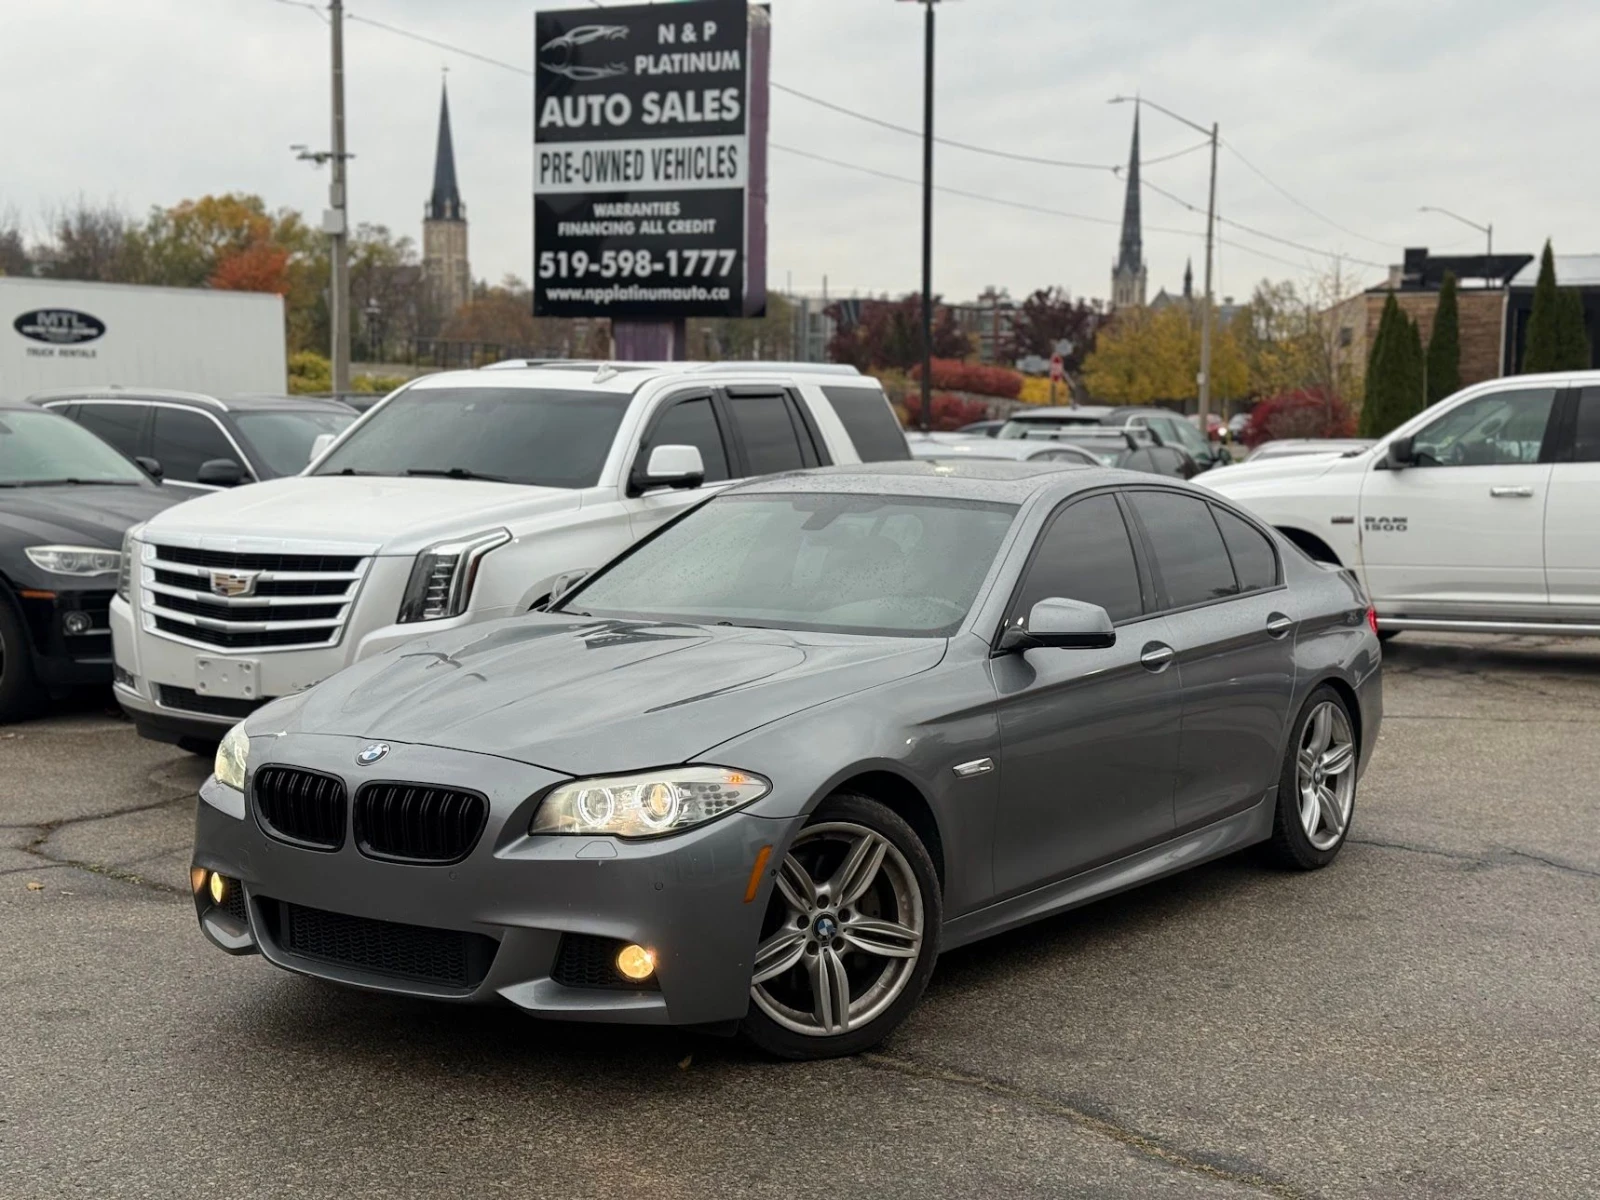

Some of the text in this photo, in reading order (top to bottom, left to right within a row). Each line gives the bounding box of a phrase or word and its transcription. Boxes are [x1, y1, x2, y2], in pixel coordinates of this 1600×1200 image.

[658, 21, 717, 44] N & P
[635, 50, 740, 75] PLATINUM
[539, 88, 740, 128] AUTO SALES
[540, 145, 737, 184] PRE-OWNED VEHICLES
[593, 202, 681, 217] WARRANTIES
[557, 219, 716, 236] FINANCING ALL CREDIT
[539, 249, 737, 278] 519-598-1777
[546, 285, 730, 304] www.npplatinumauto.ca
[37, 312, 86, 328] MTL
[1364, 516, 1408, 524] RAM
[1364, 523, 1408, 532] 1500
